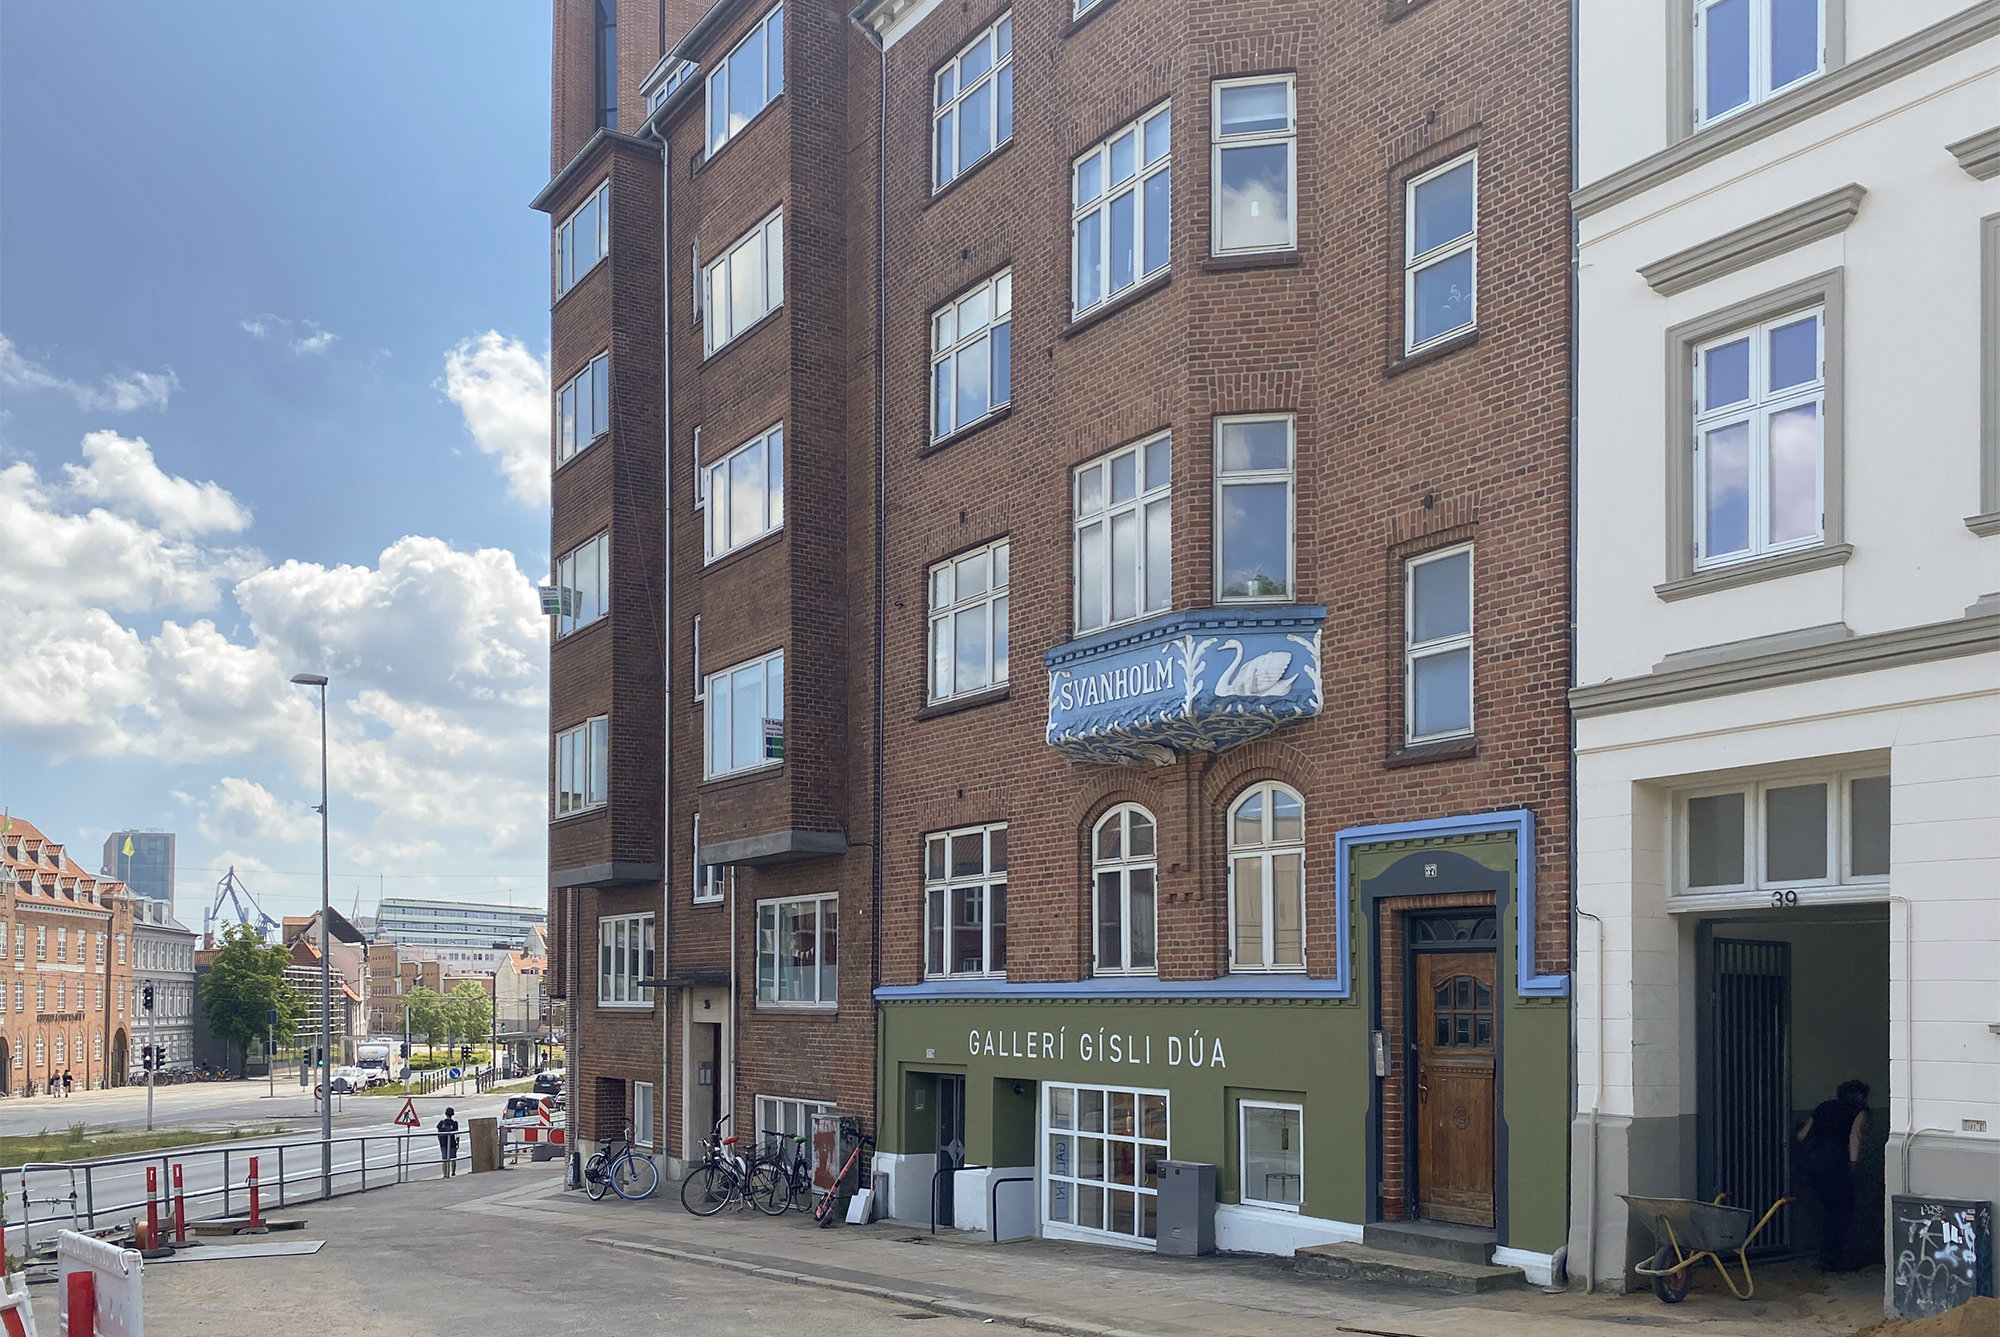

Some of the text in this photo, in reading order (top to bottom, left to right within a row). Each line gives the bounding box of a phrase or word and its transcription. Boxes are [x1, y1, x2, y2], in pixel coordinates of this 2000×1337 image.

[1060, 657, 1174, 712] SVANHOLM
[1772, 890, 1796, 908] 39
[969, 1026, 1226, 1068] GALLERÍ GÍSLI DÚA
